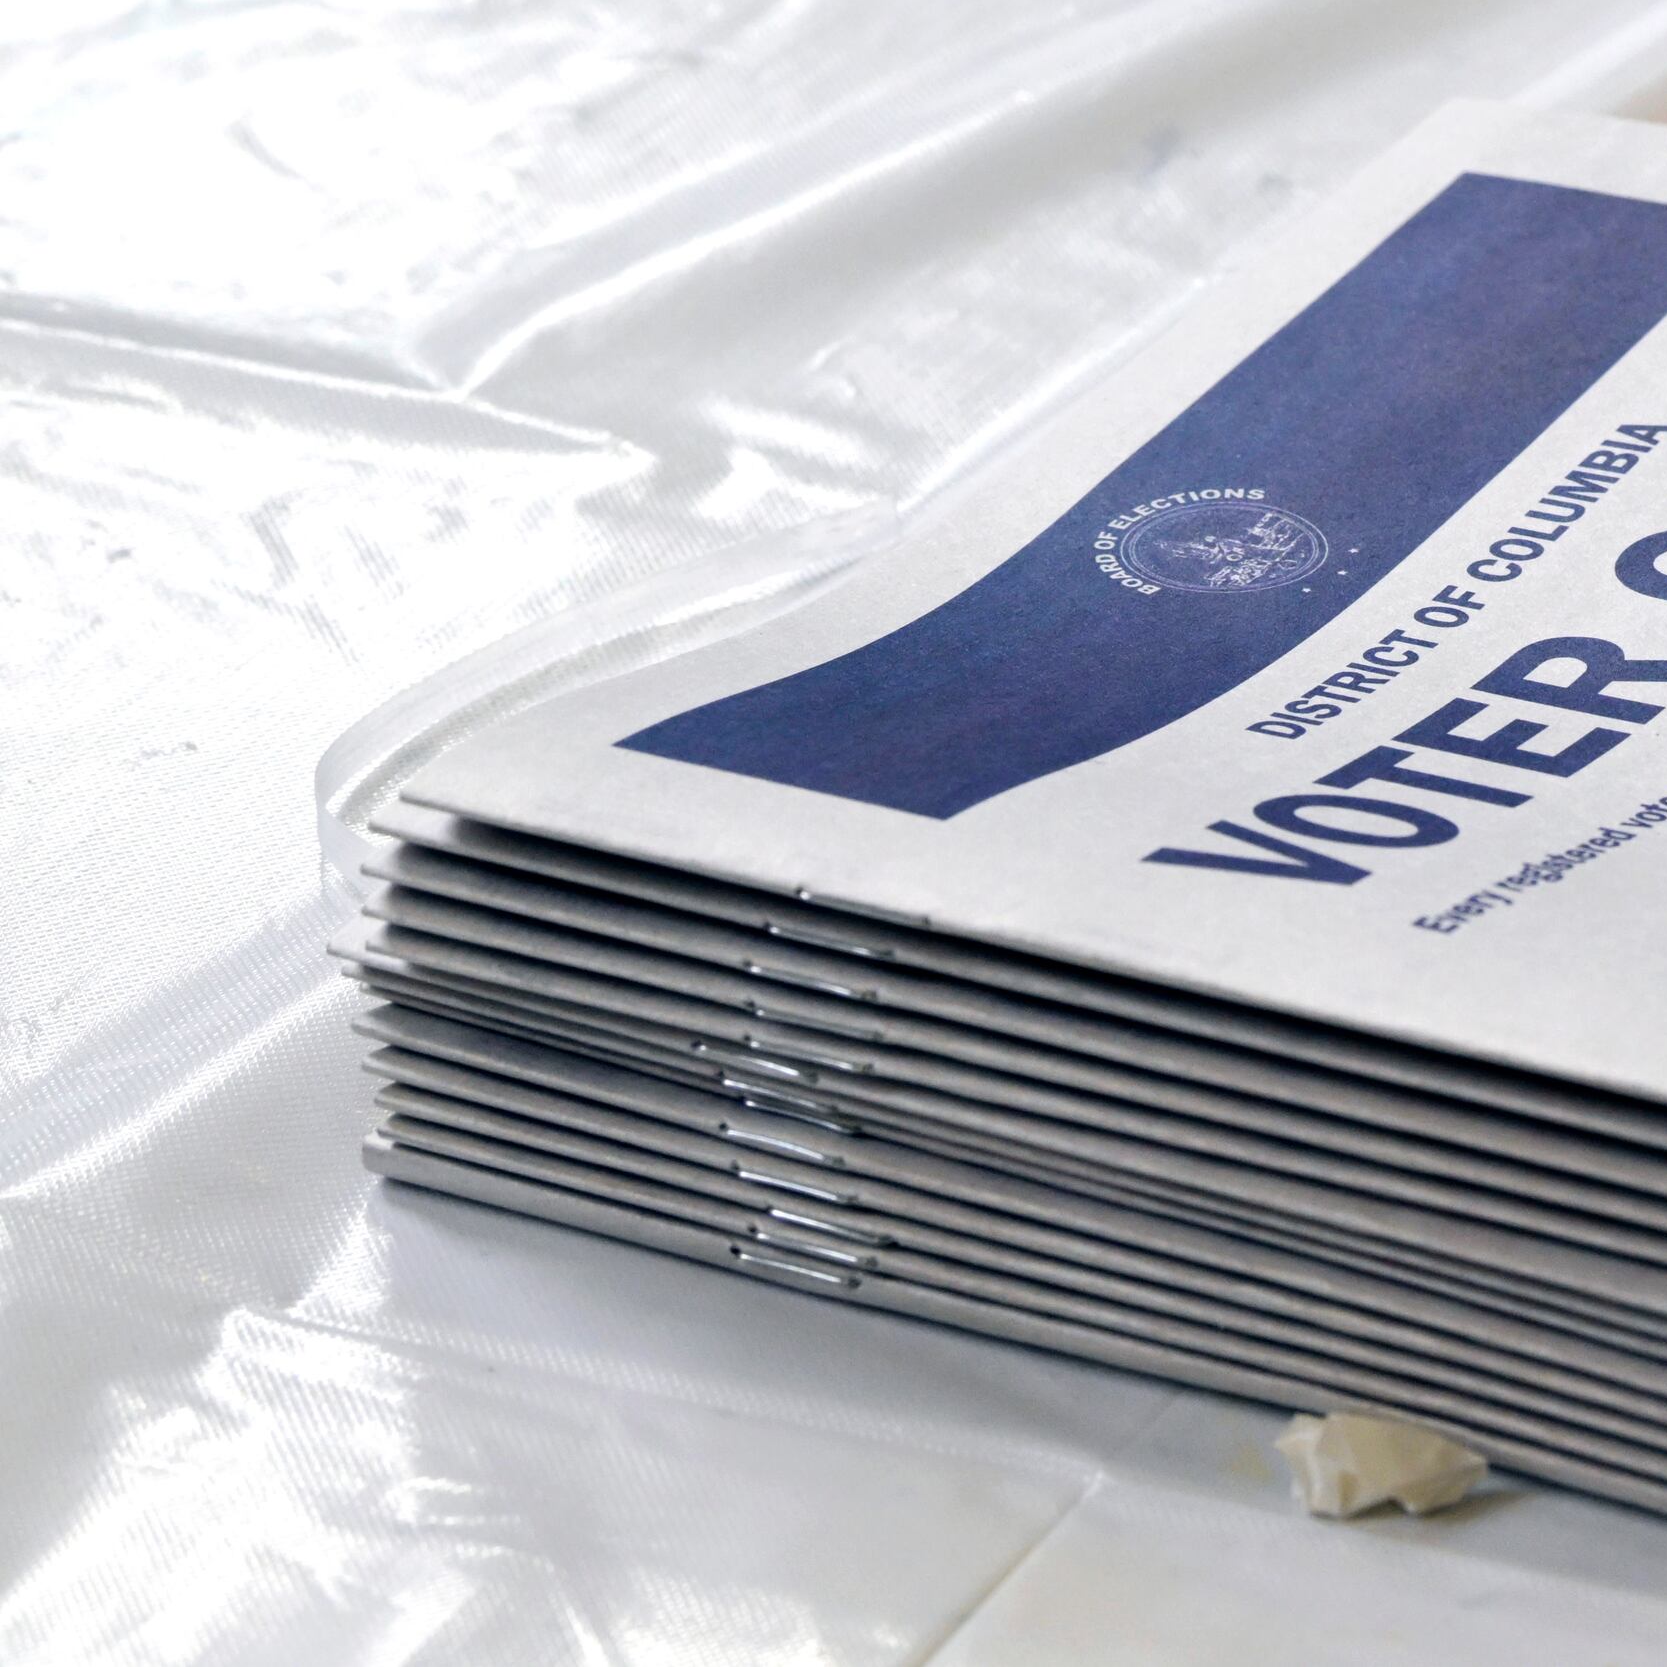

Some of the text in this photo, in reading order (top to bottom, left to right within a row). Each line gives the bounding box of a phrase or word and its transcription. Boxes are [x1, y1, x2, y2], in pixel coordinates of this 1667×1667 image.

[1094, 488, 1266, 595] BOARD OF ELECTIONS
[1245, 628, 1439, 740] DISTRICT
[1413, 584, 1486, 629] OF
[1412, 890, 1513, 934] Every
[1495, 826, 1637, 892] registered
